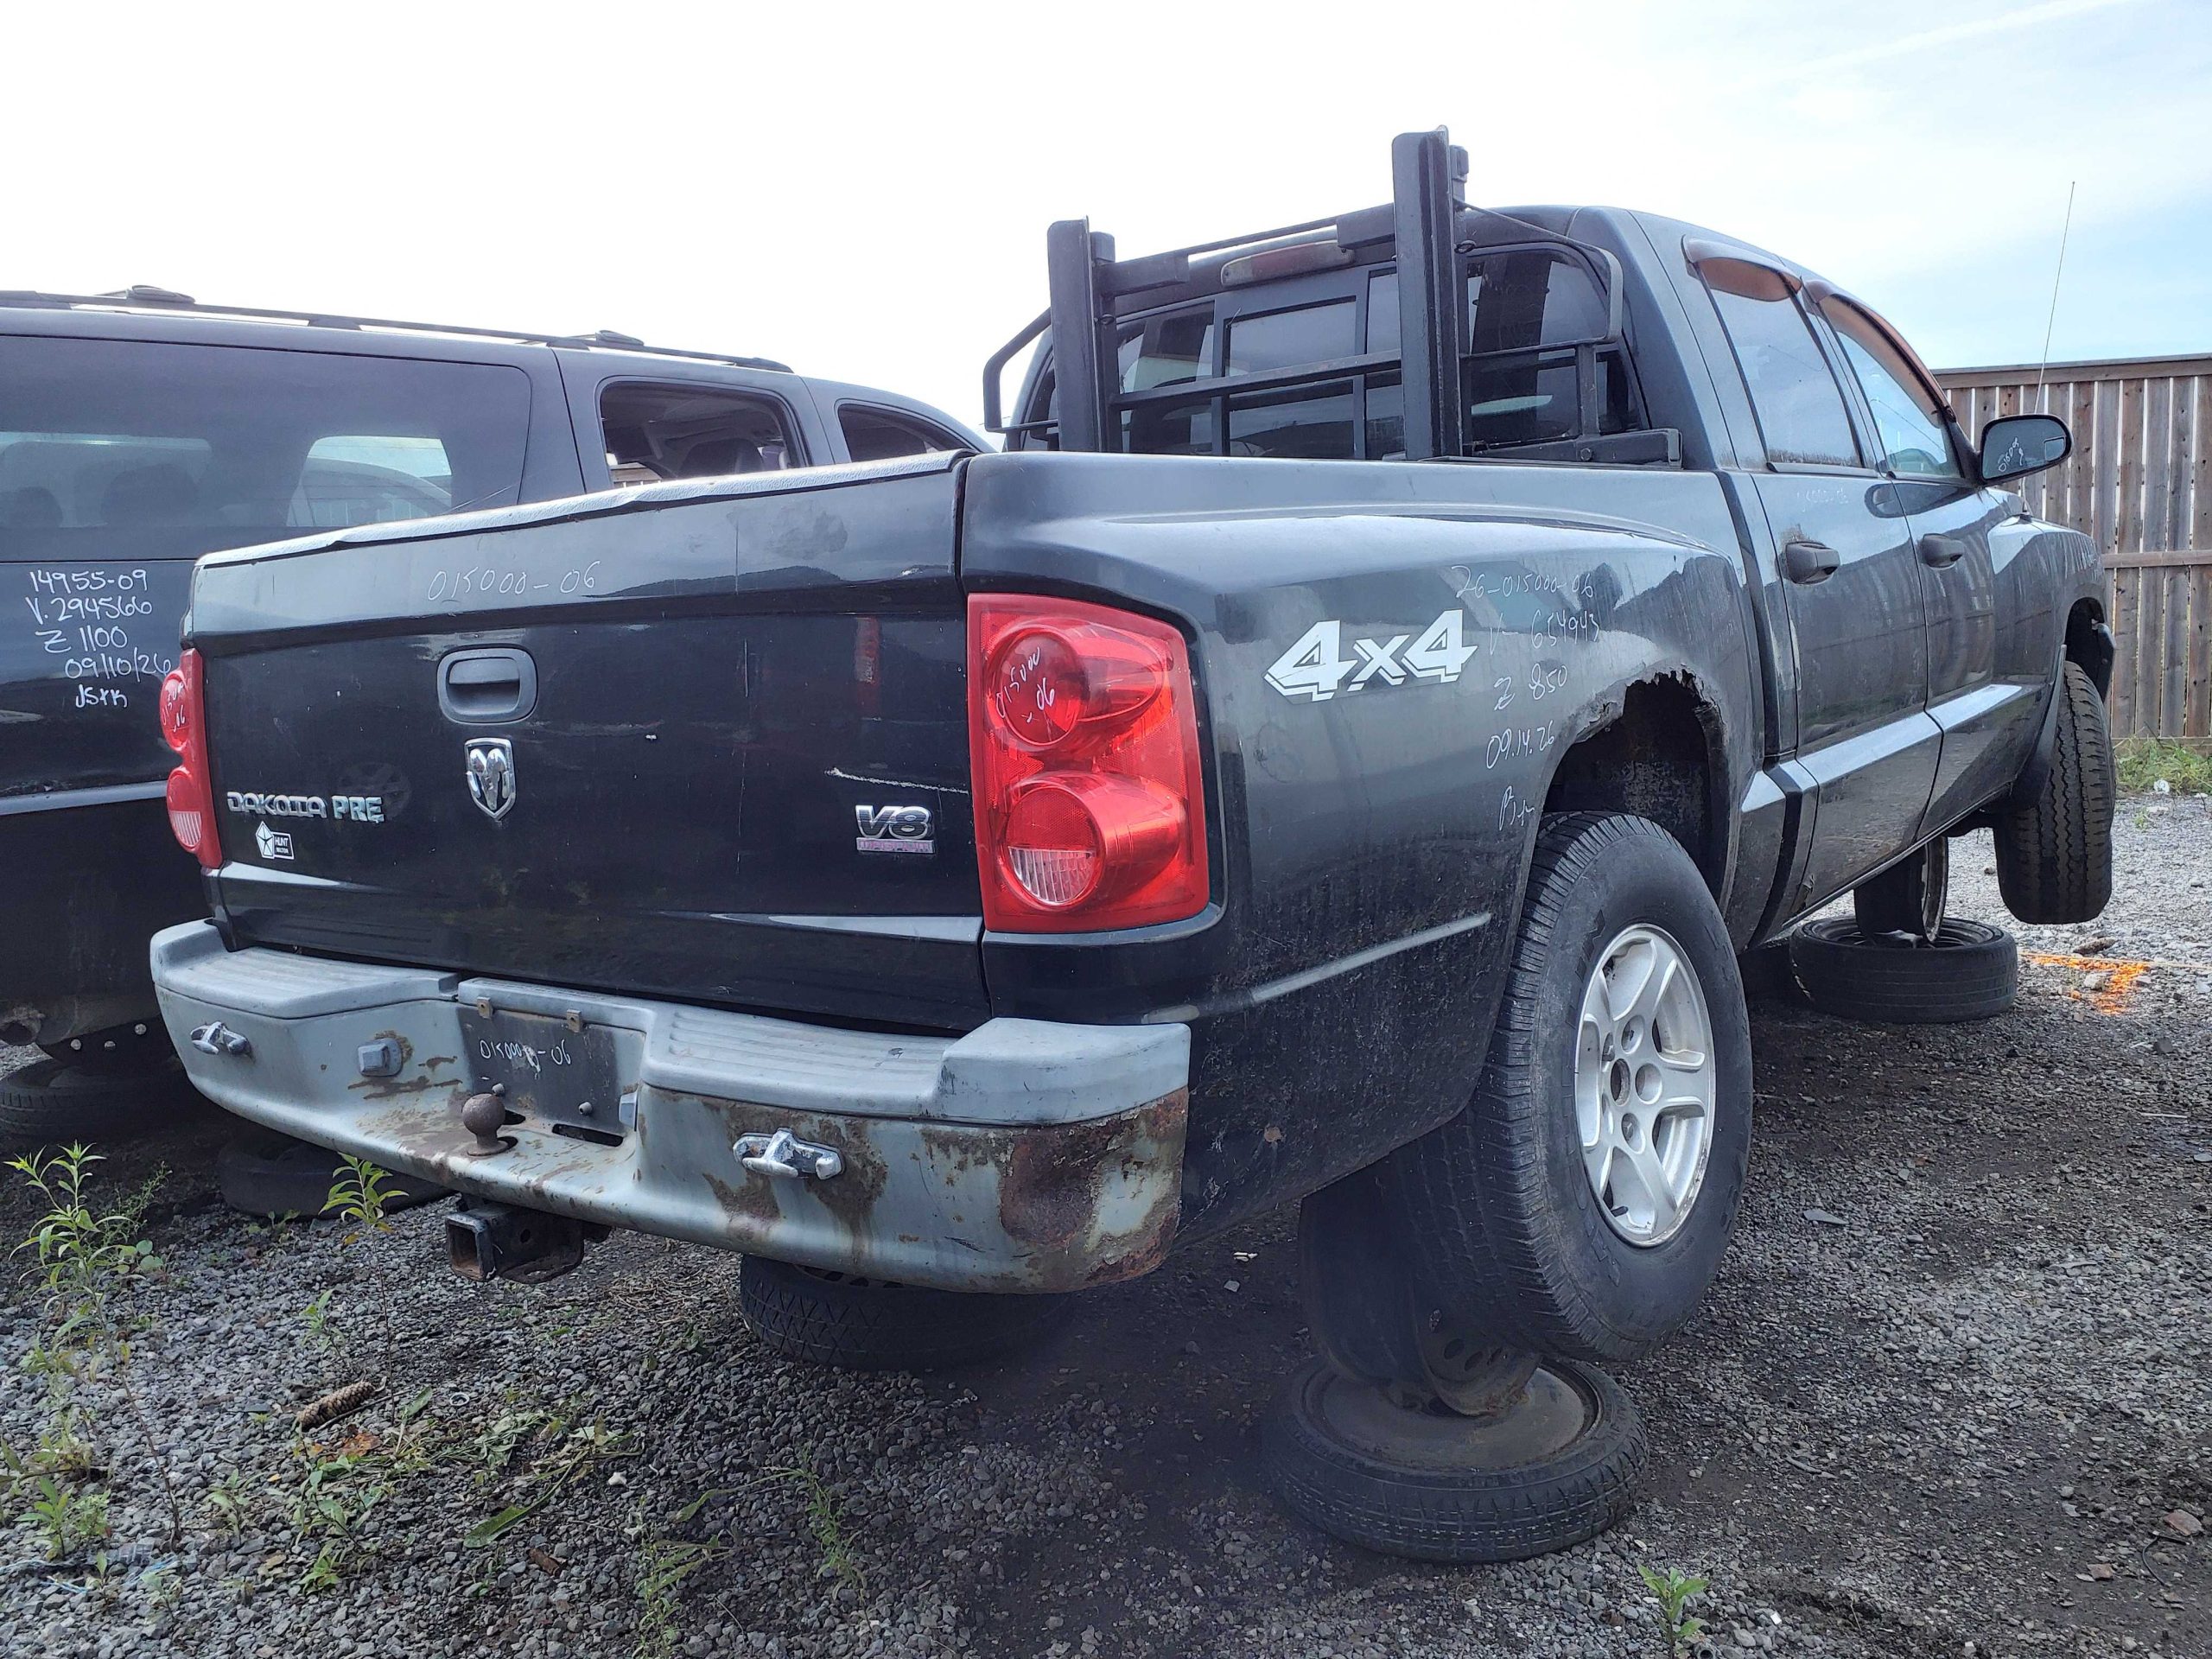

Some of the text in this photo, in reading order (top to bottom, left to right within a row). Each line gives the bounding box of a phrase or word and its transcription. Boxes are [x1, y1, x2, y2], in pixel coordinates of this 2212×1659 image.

[29, 569, 148, 594] 14955-09
[50, 595, 153, 621] 294566
[35, 625, 128, 653] Z 1100
[1531, 609, 1599, 649] 654943
[65, 646, 172, 683] 09/10/26
[1262, 608, 1478, 702] 4x4
[1528, 663, 1568, 701] 850
[226, 791, 385, 823] DAKOTA PRE
[855, 804, 933, 840] V8
